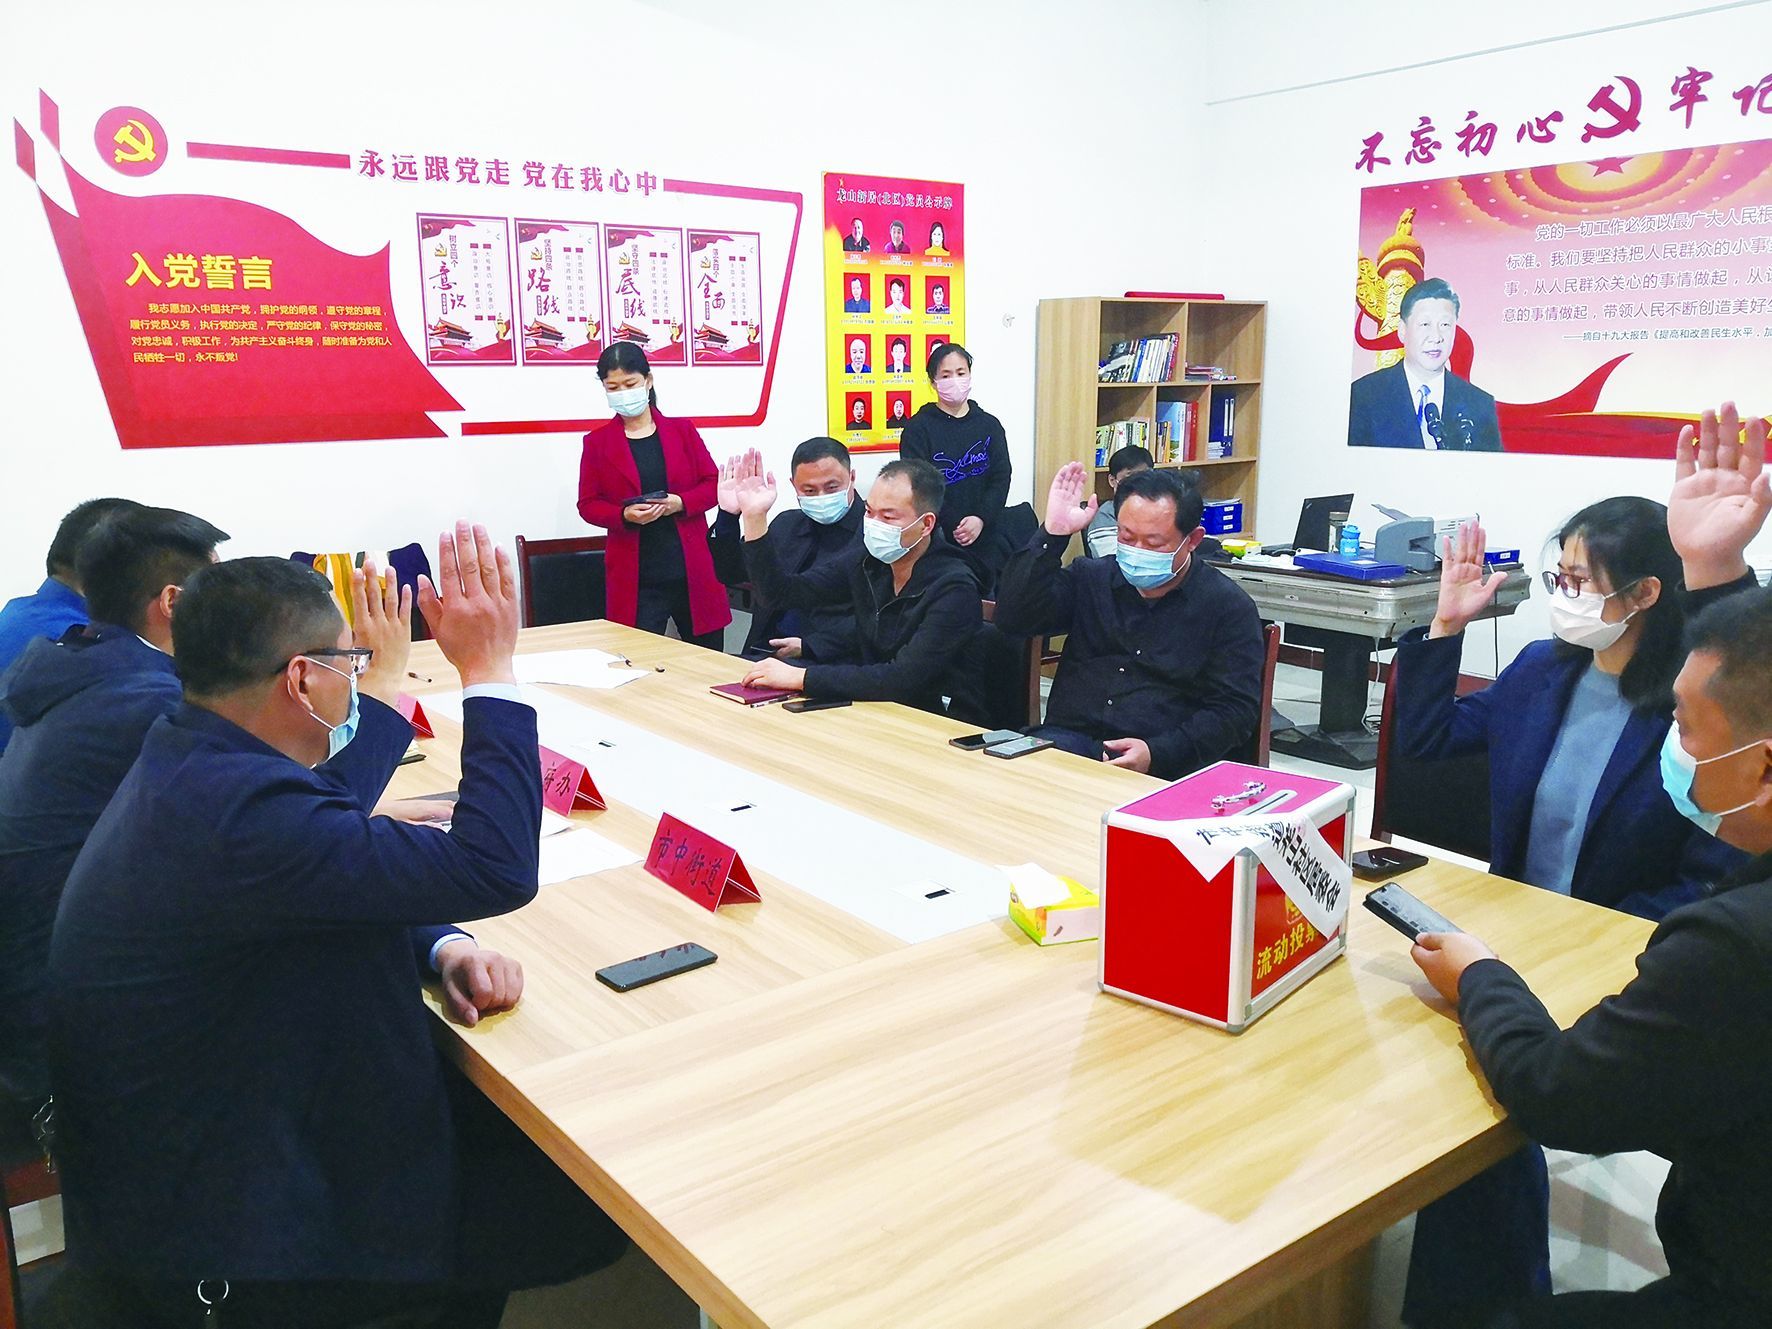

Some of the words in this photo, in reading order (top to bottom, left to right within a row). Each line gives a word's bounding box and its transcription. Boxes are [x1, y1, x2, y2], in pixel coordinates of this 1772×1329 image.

[1355, 111, 1564, 173] 不忘初心
[359, 149, 511, 186] 永远跟党走
[522, 160, 658, 197] 党在我心中
[1536, 206, 1772, 241] 党的一切工作必须以最广大人民根
[125, 251, 273, 290] 入党誓言
[1507, 237, 1772, 269] 标准。我们要坚持把人民群众的小事
[429, 261, 467, 310] 意识
[527, 267, 560, 316] 路线
[615, 268, 646, 318] 底线
[697, 273, 726, 311] 全面
[654, 828, 723, 896] 市中街道
